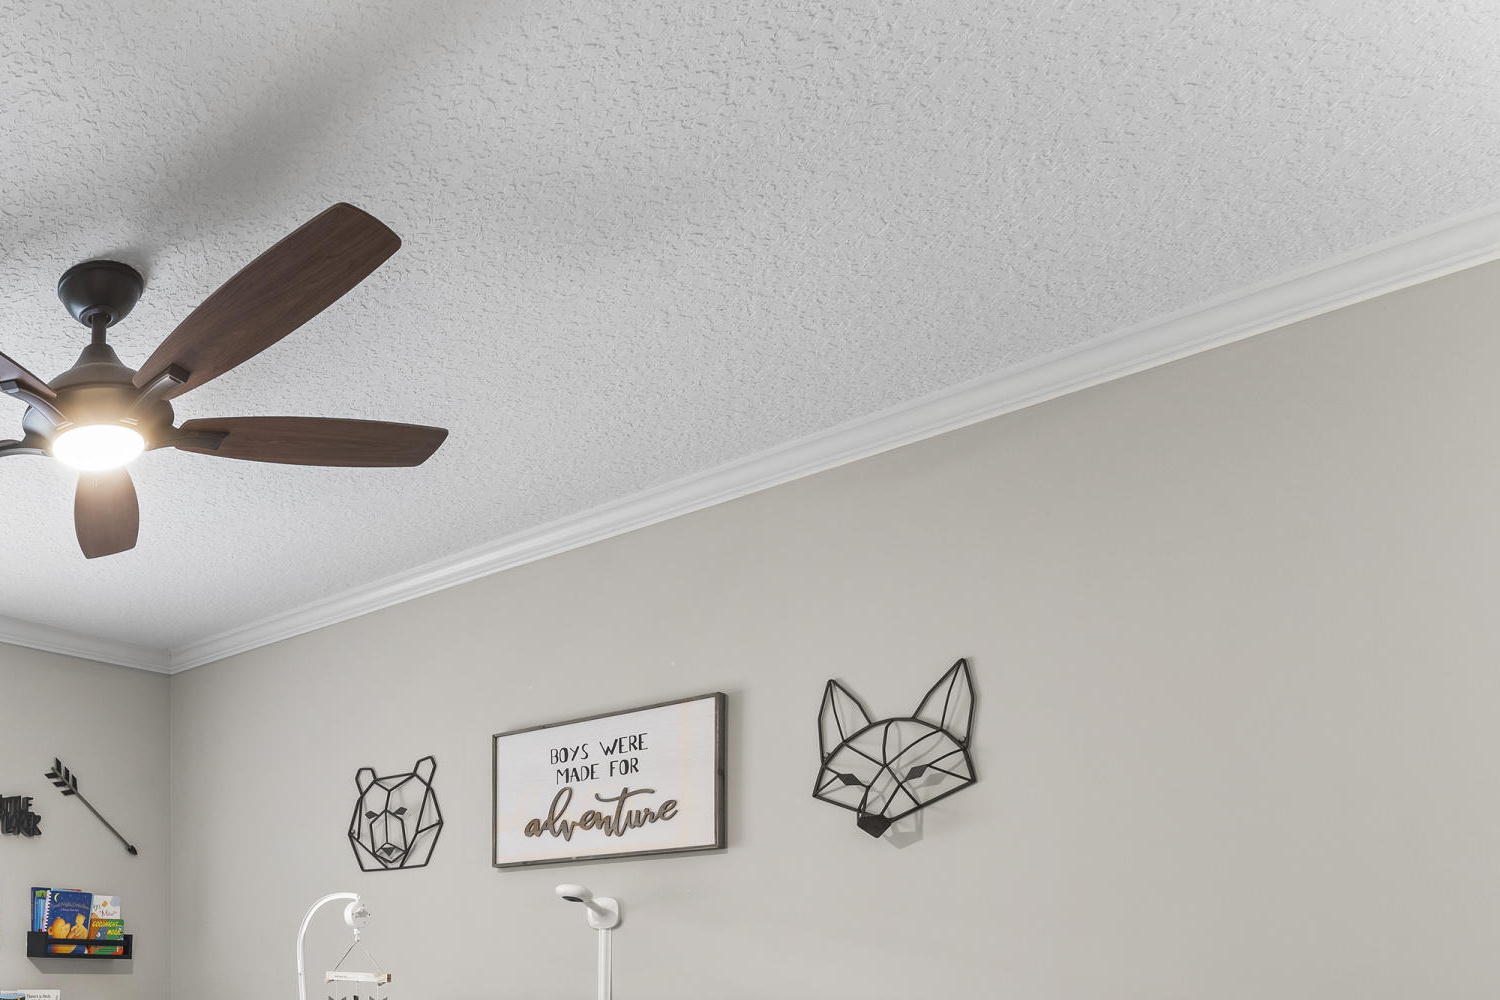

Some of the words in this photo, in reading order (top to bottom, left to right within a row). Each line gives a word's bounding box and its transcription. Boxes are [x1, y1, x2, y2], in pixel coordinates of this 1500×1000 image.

[550, 743, 589, 765] BOYS
[599, 732, 649, 756] WERE
[556, 763, 600, 785] MADE
[609, 757, 640, 778] FOR
[524, 786, 679, 842] adventure
